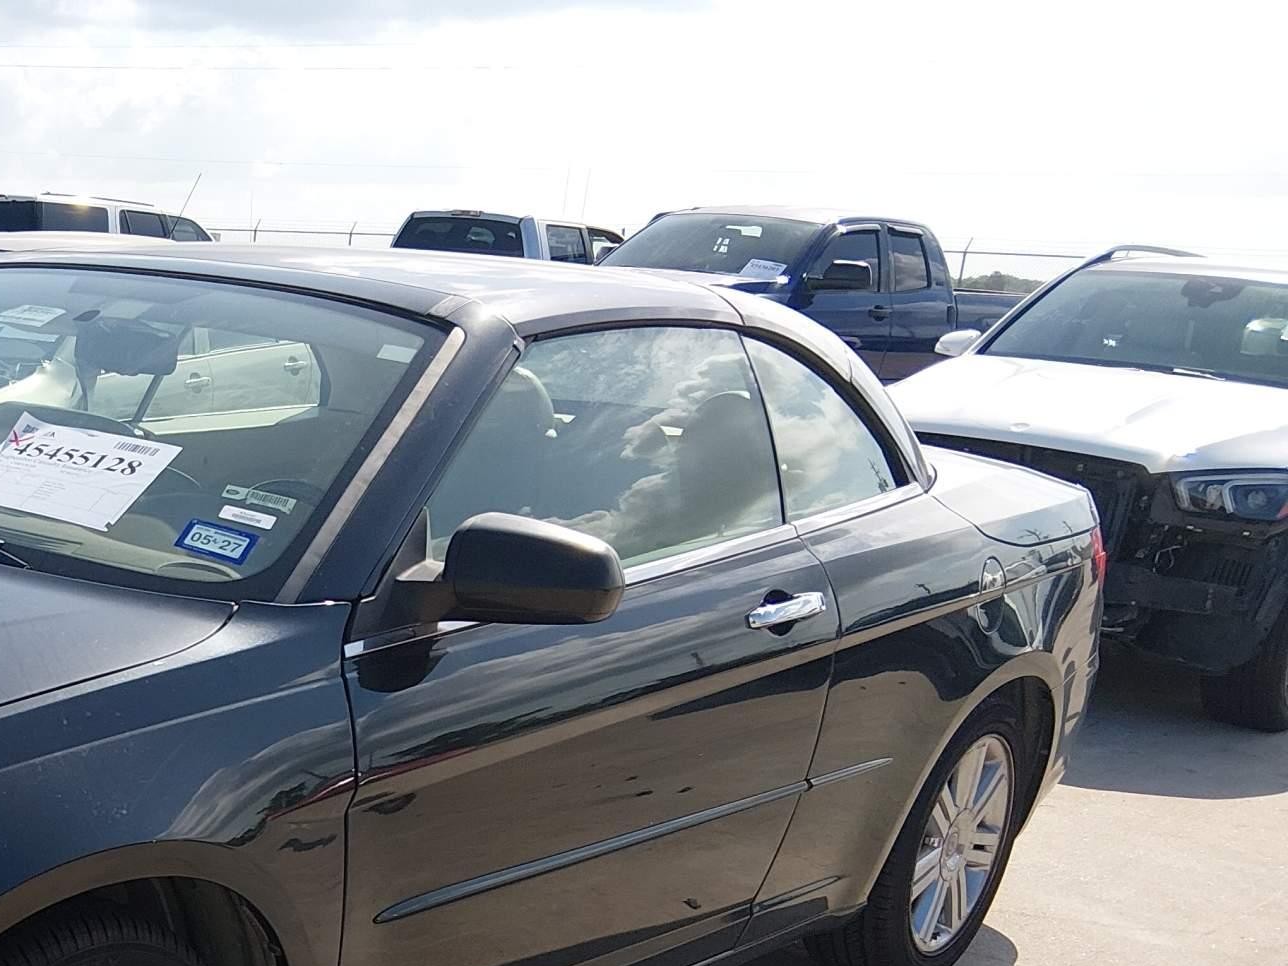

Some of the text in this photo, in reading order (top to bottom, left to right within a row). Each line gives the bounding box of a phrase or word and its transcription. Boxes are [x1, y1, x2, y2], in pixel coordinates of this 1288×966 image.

[14, 441, 144, 476] 45455128
[191, 532, 213, 545] 05
[219, 540, 243, 552] 27
